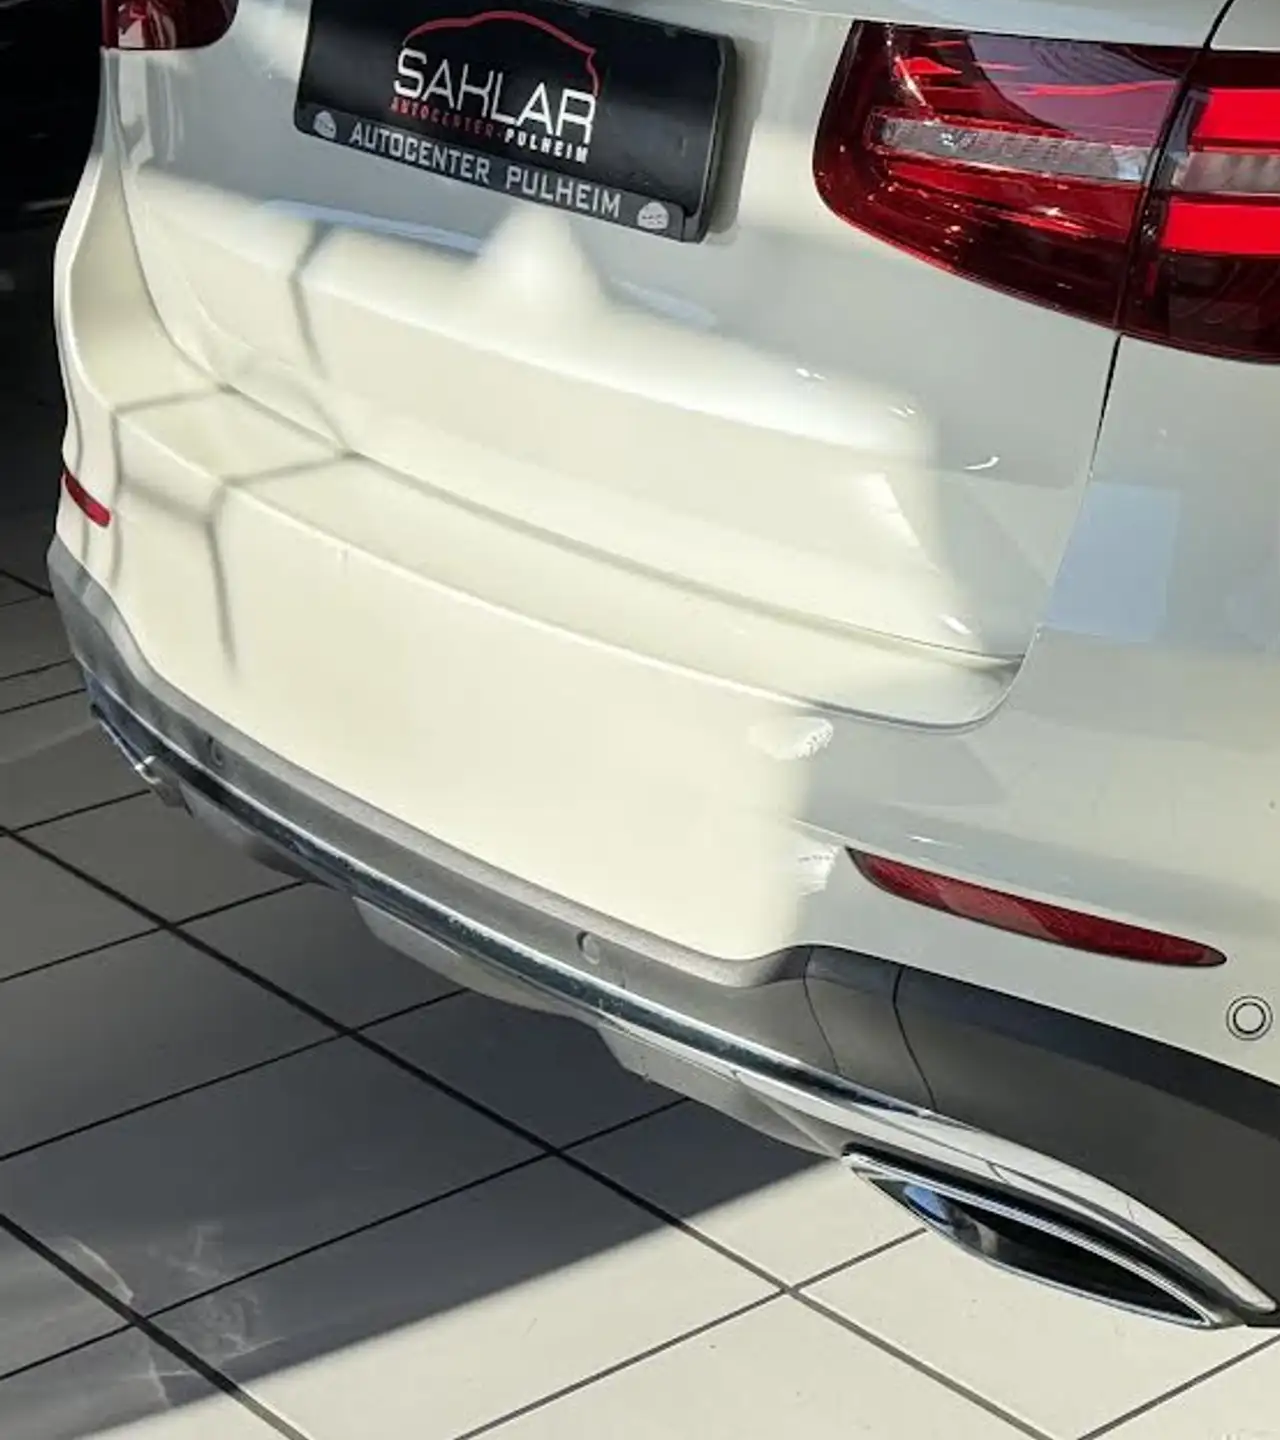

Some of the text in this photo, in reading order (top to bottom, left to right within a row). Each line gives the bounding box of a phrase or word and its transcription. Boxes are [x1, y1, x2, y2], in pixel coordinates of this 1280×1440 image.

[392, 47, 596, 145] SAHLAR
[349, 121, 490, 185] AUTOCENTER
[505, 165, 622, 219] PULHEIM
